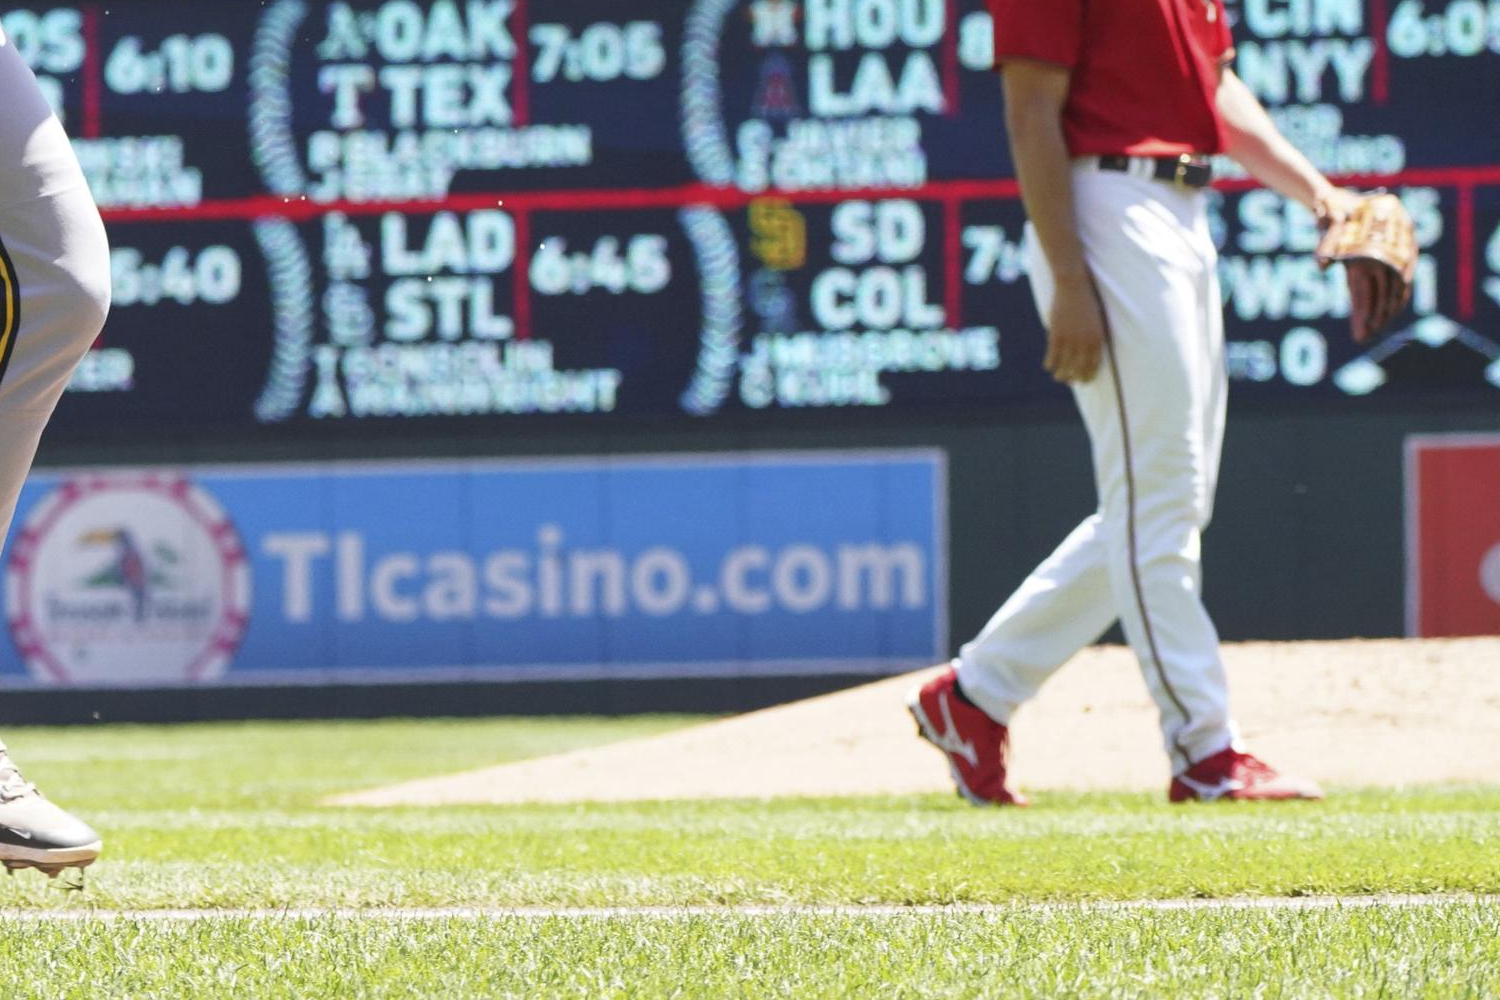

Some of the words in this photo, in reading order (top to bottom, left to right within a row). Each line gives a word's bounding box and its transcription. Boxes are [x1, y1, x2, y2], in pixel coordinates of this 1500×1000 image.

[104, 32, 235, 95] 6:10
[528, 20, 668, 83] 7:05
[807, 50, 948, 118] LAA
[1237, 37, 1376, 104] NYY
[379, 62, 514, 128] TEX
[379, 208, 516, 276] LAD
[529, 233, 672, 295] 6:45
[830, 198, 926, 264] SD
[383, 277, 516, 341] STL
[810, 264, 948, 331] COL
